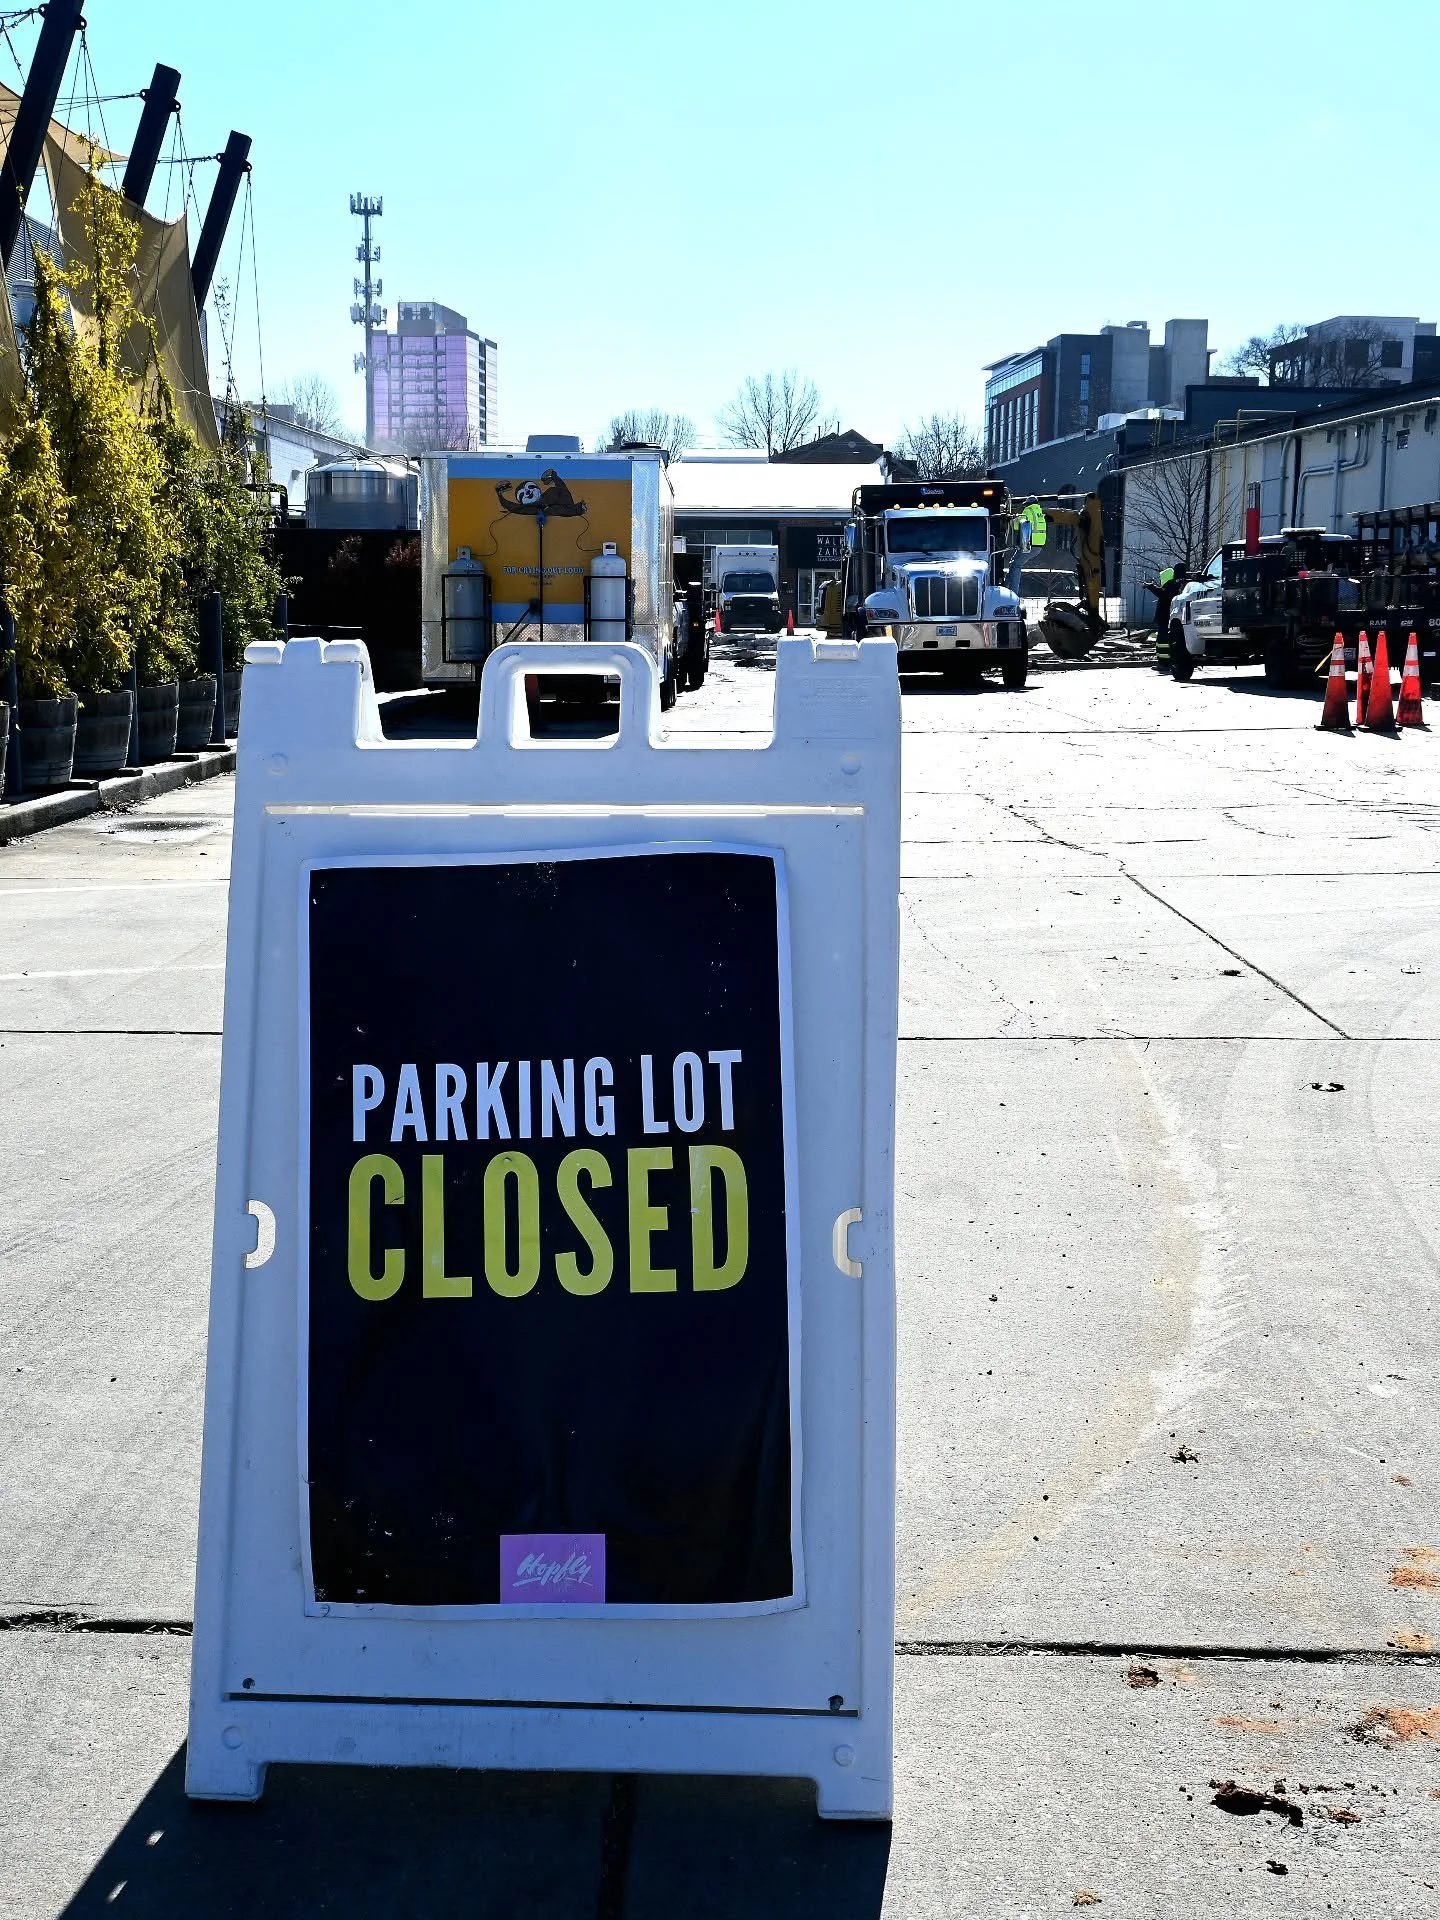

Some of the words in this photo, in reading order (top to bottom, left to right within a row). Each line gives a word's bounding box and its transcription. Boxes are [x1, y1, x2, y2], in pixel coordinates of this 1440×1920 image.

[818, 547, 845, 556] ZAN
[503, 566, 517, 574] FOR
[547, 566, 562, 574] OUT
[563, 566, 584, 574] LOUD
[352, 1056, 617, 1142] PARKING
[640, 1049, 742, 1134] LOT
[348, 1144, 750, 1301] CLOSED
[515, 1552, 593, 1587] Hopfly
